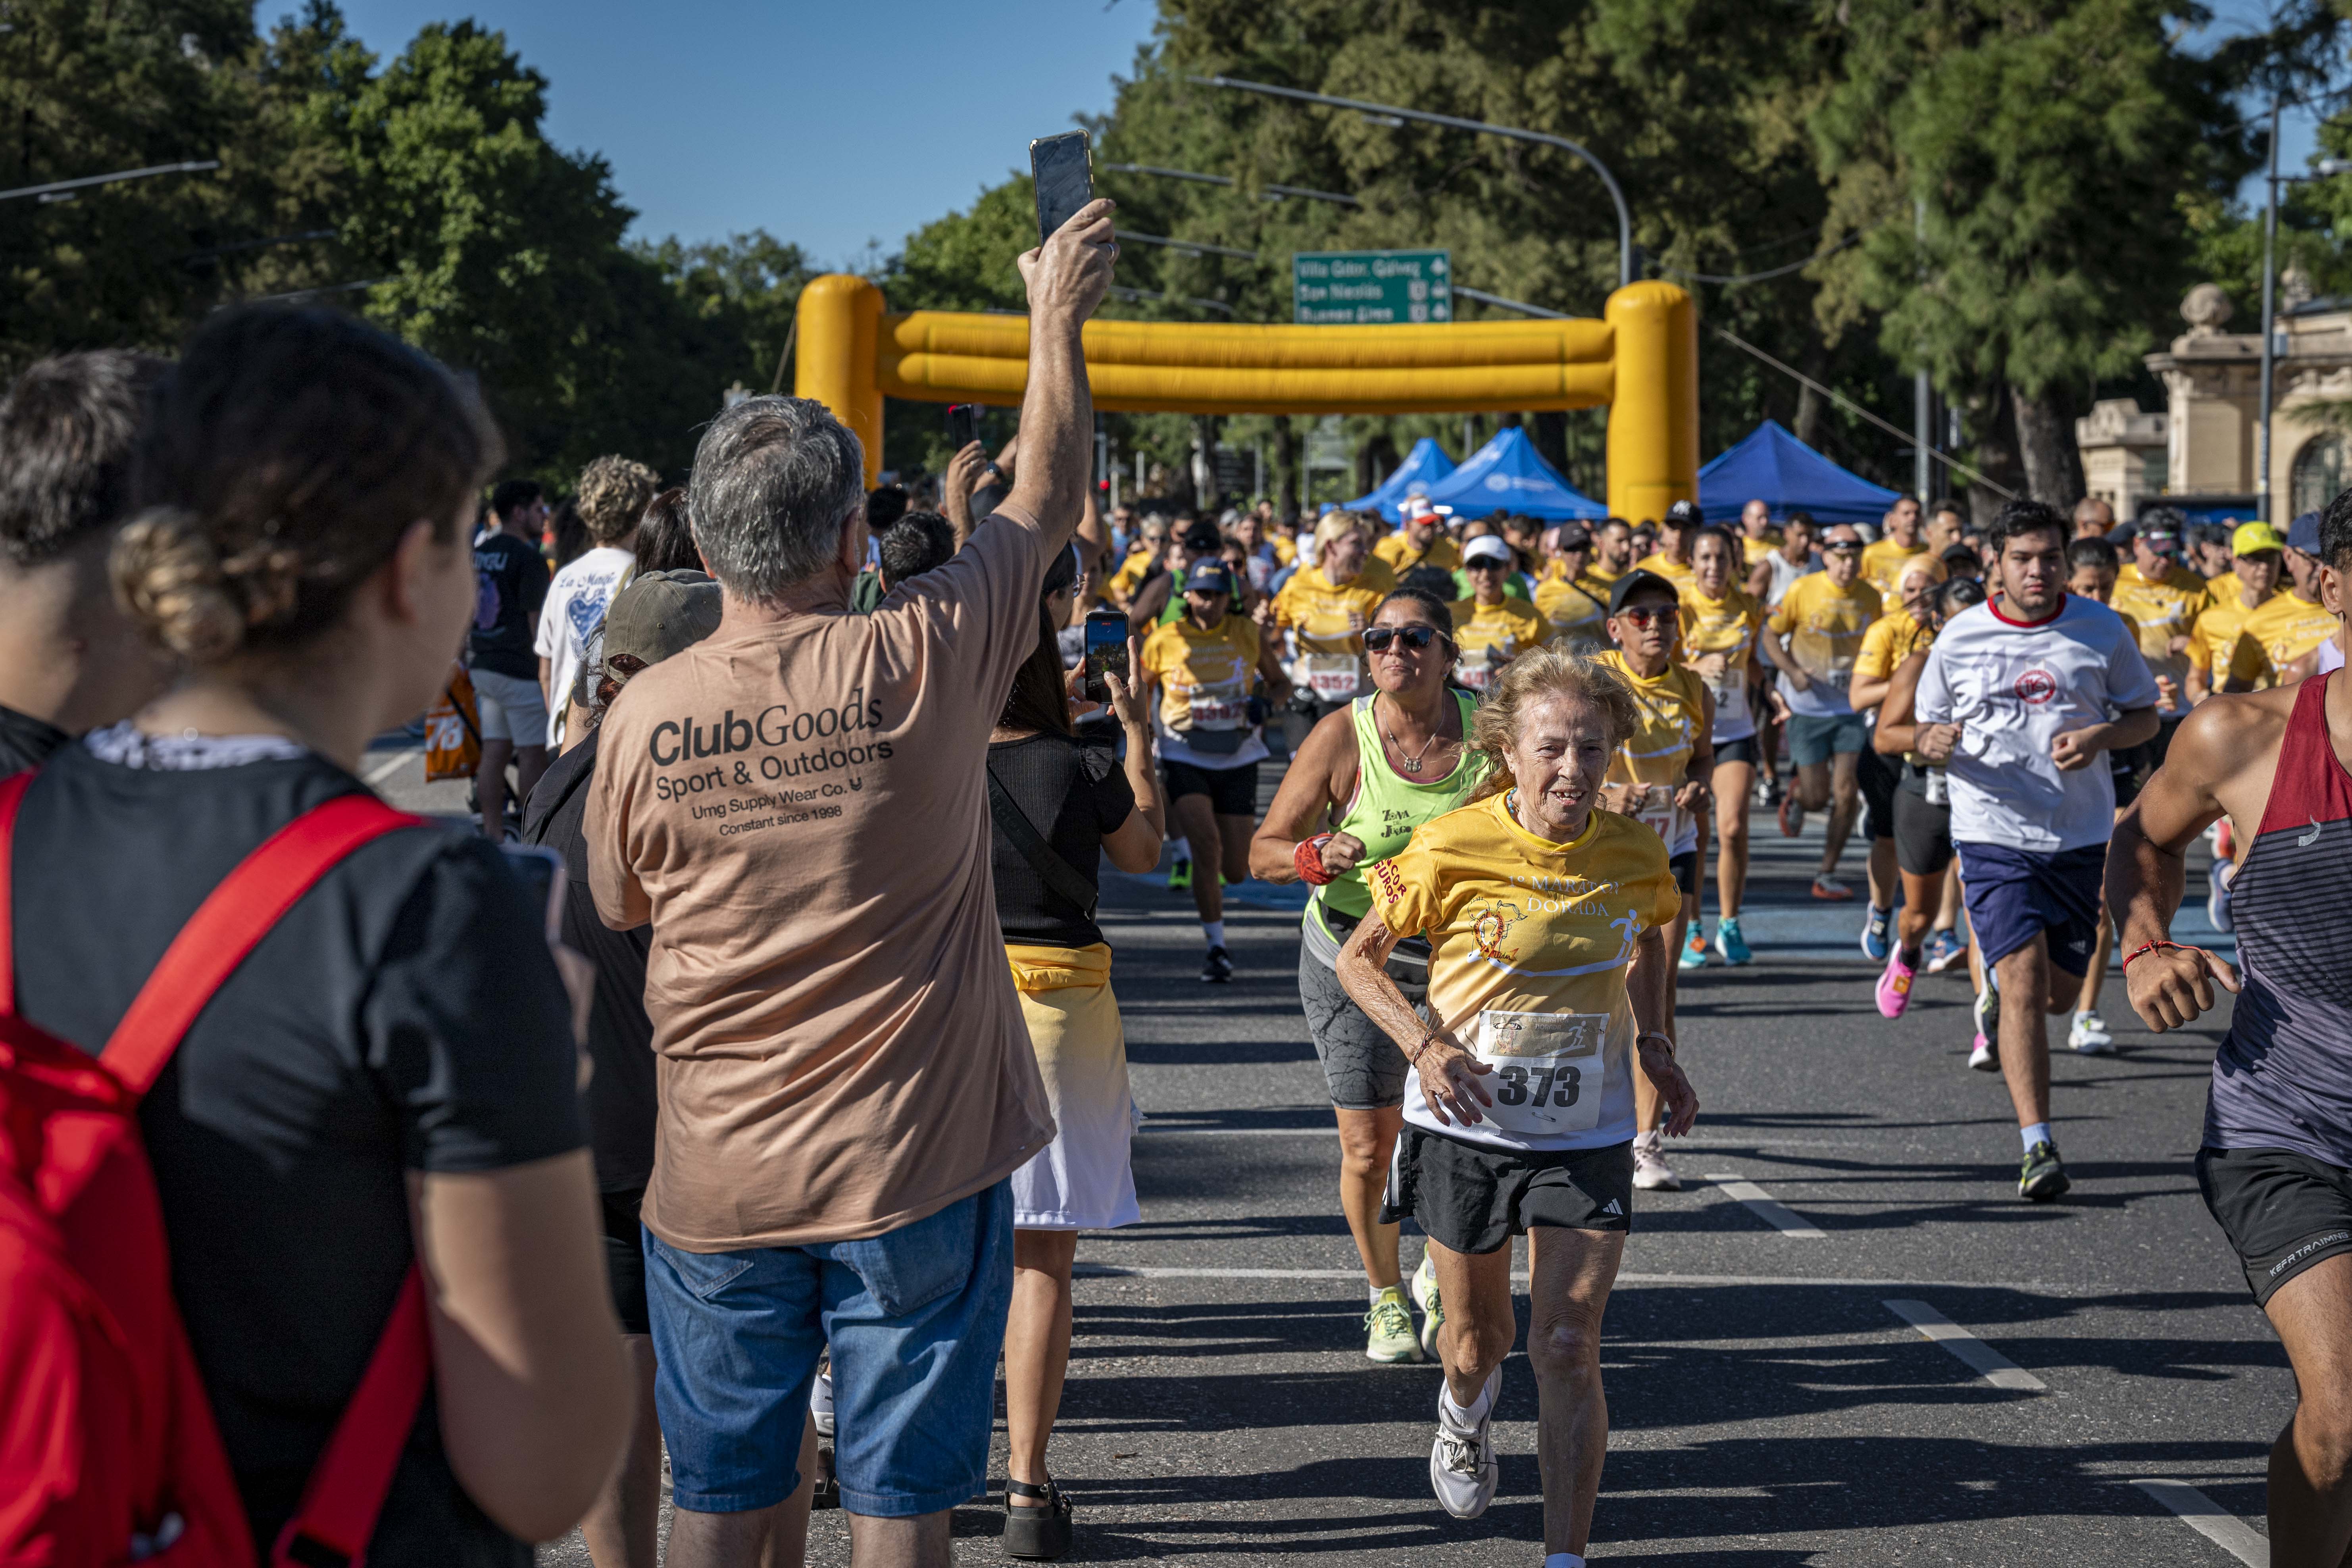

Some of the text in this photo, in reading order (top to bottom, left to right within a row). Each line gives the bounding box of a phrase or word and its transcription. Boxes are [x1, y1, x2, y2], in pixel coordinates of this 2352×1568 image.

[656, 740, 894, 804] Sport & Outdoors
[692, 783, 848, 820] Umg Supply Wear Co.
[719, 805, 842, 836] Constant since 1998
[1527, 897, 1610, 916] DORADA
[1497, 1066, 1581, 1108] 373
